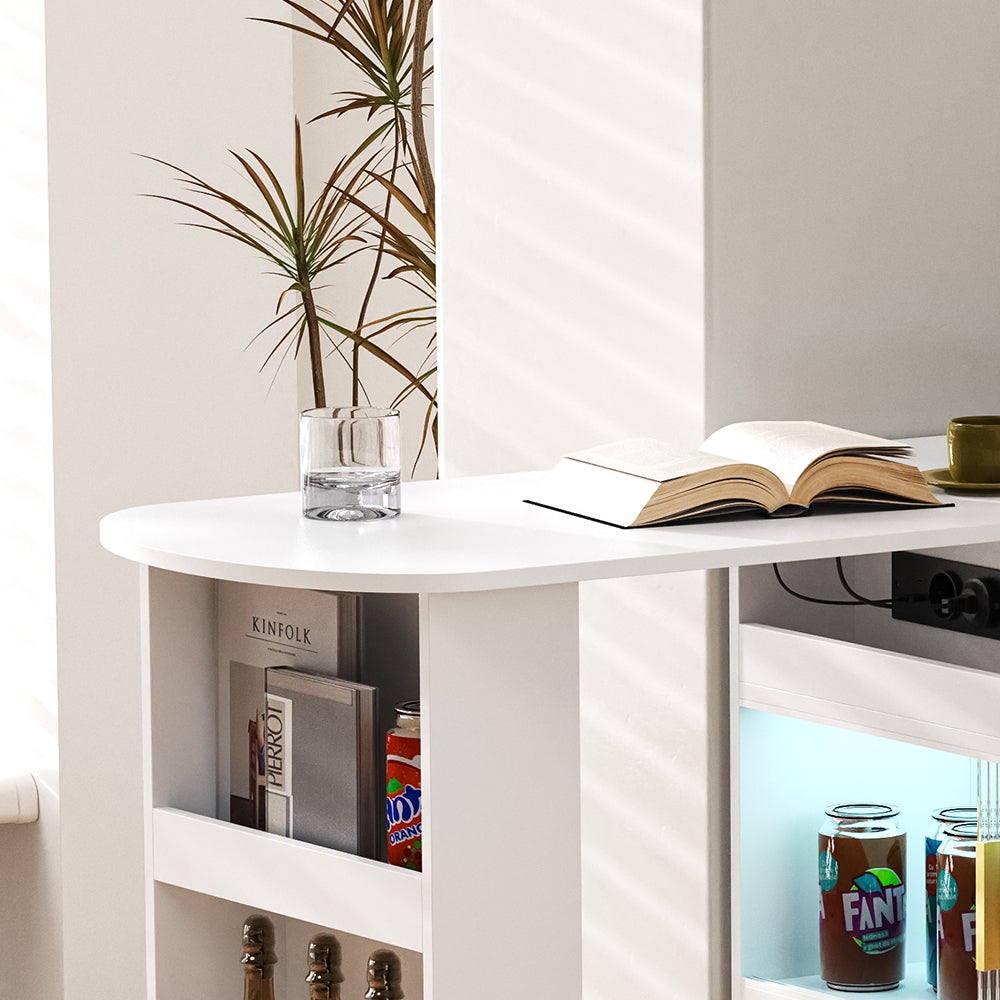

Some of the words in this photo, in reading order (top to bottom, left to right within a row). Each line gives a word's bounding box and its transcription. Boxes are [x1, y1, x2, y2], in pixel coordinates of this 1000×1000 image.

[252, 616, 311, 645] KINFOLK
[266, 706, 283, 787] PIERROT
[390, 822, 422, 846] ORANG
